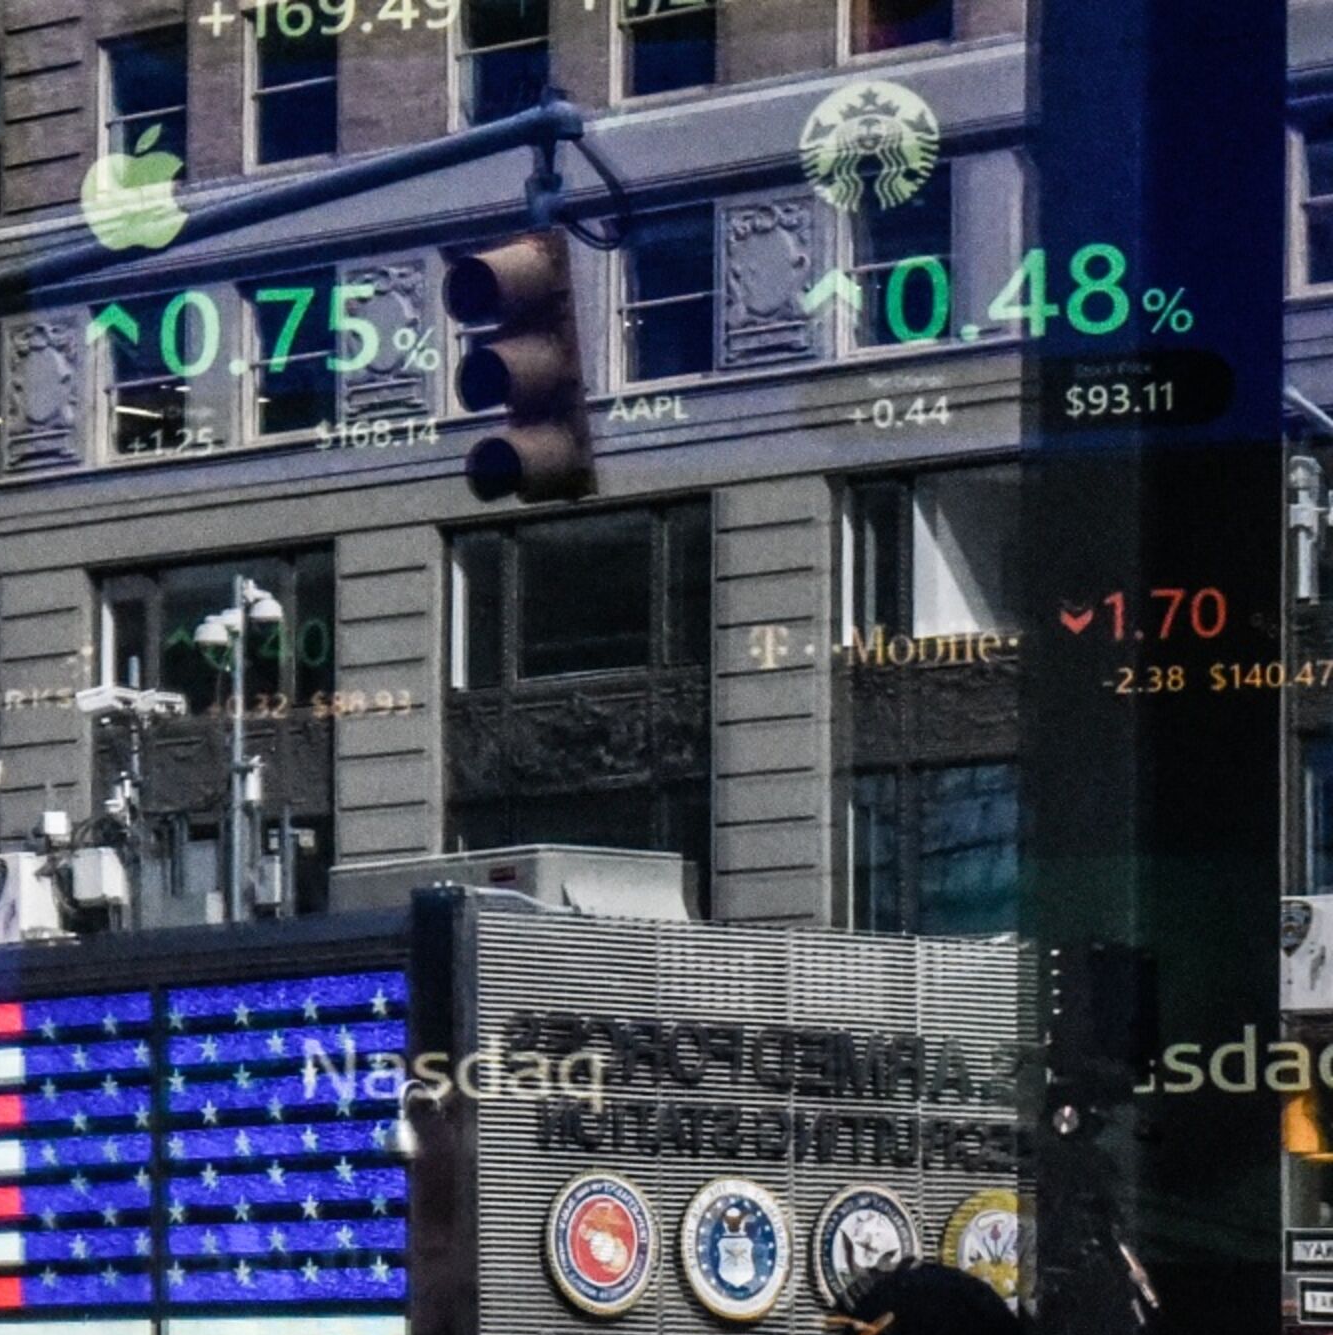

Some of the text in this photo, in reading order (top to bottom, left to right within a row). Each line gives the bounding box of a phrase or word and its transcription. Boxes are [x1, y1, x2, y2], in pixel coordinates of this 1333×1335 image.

[884, 242, 1194, 343] 0.48%
[159, 286, 440, 378] 0.75%
[608, 395, 690, 422] AAPL
[851, 397, 951, 429] +0.44
[1064, 380, 1176, 418] $93.11
[1102, 666, 1186, 695] -2.38
[303, 1038, 605, 1112] Nasdaq
